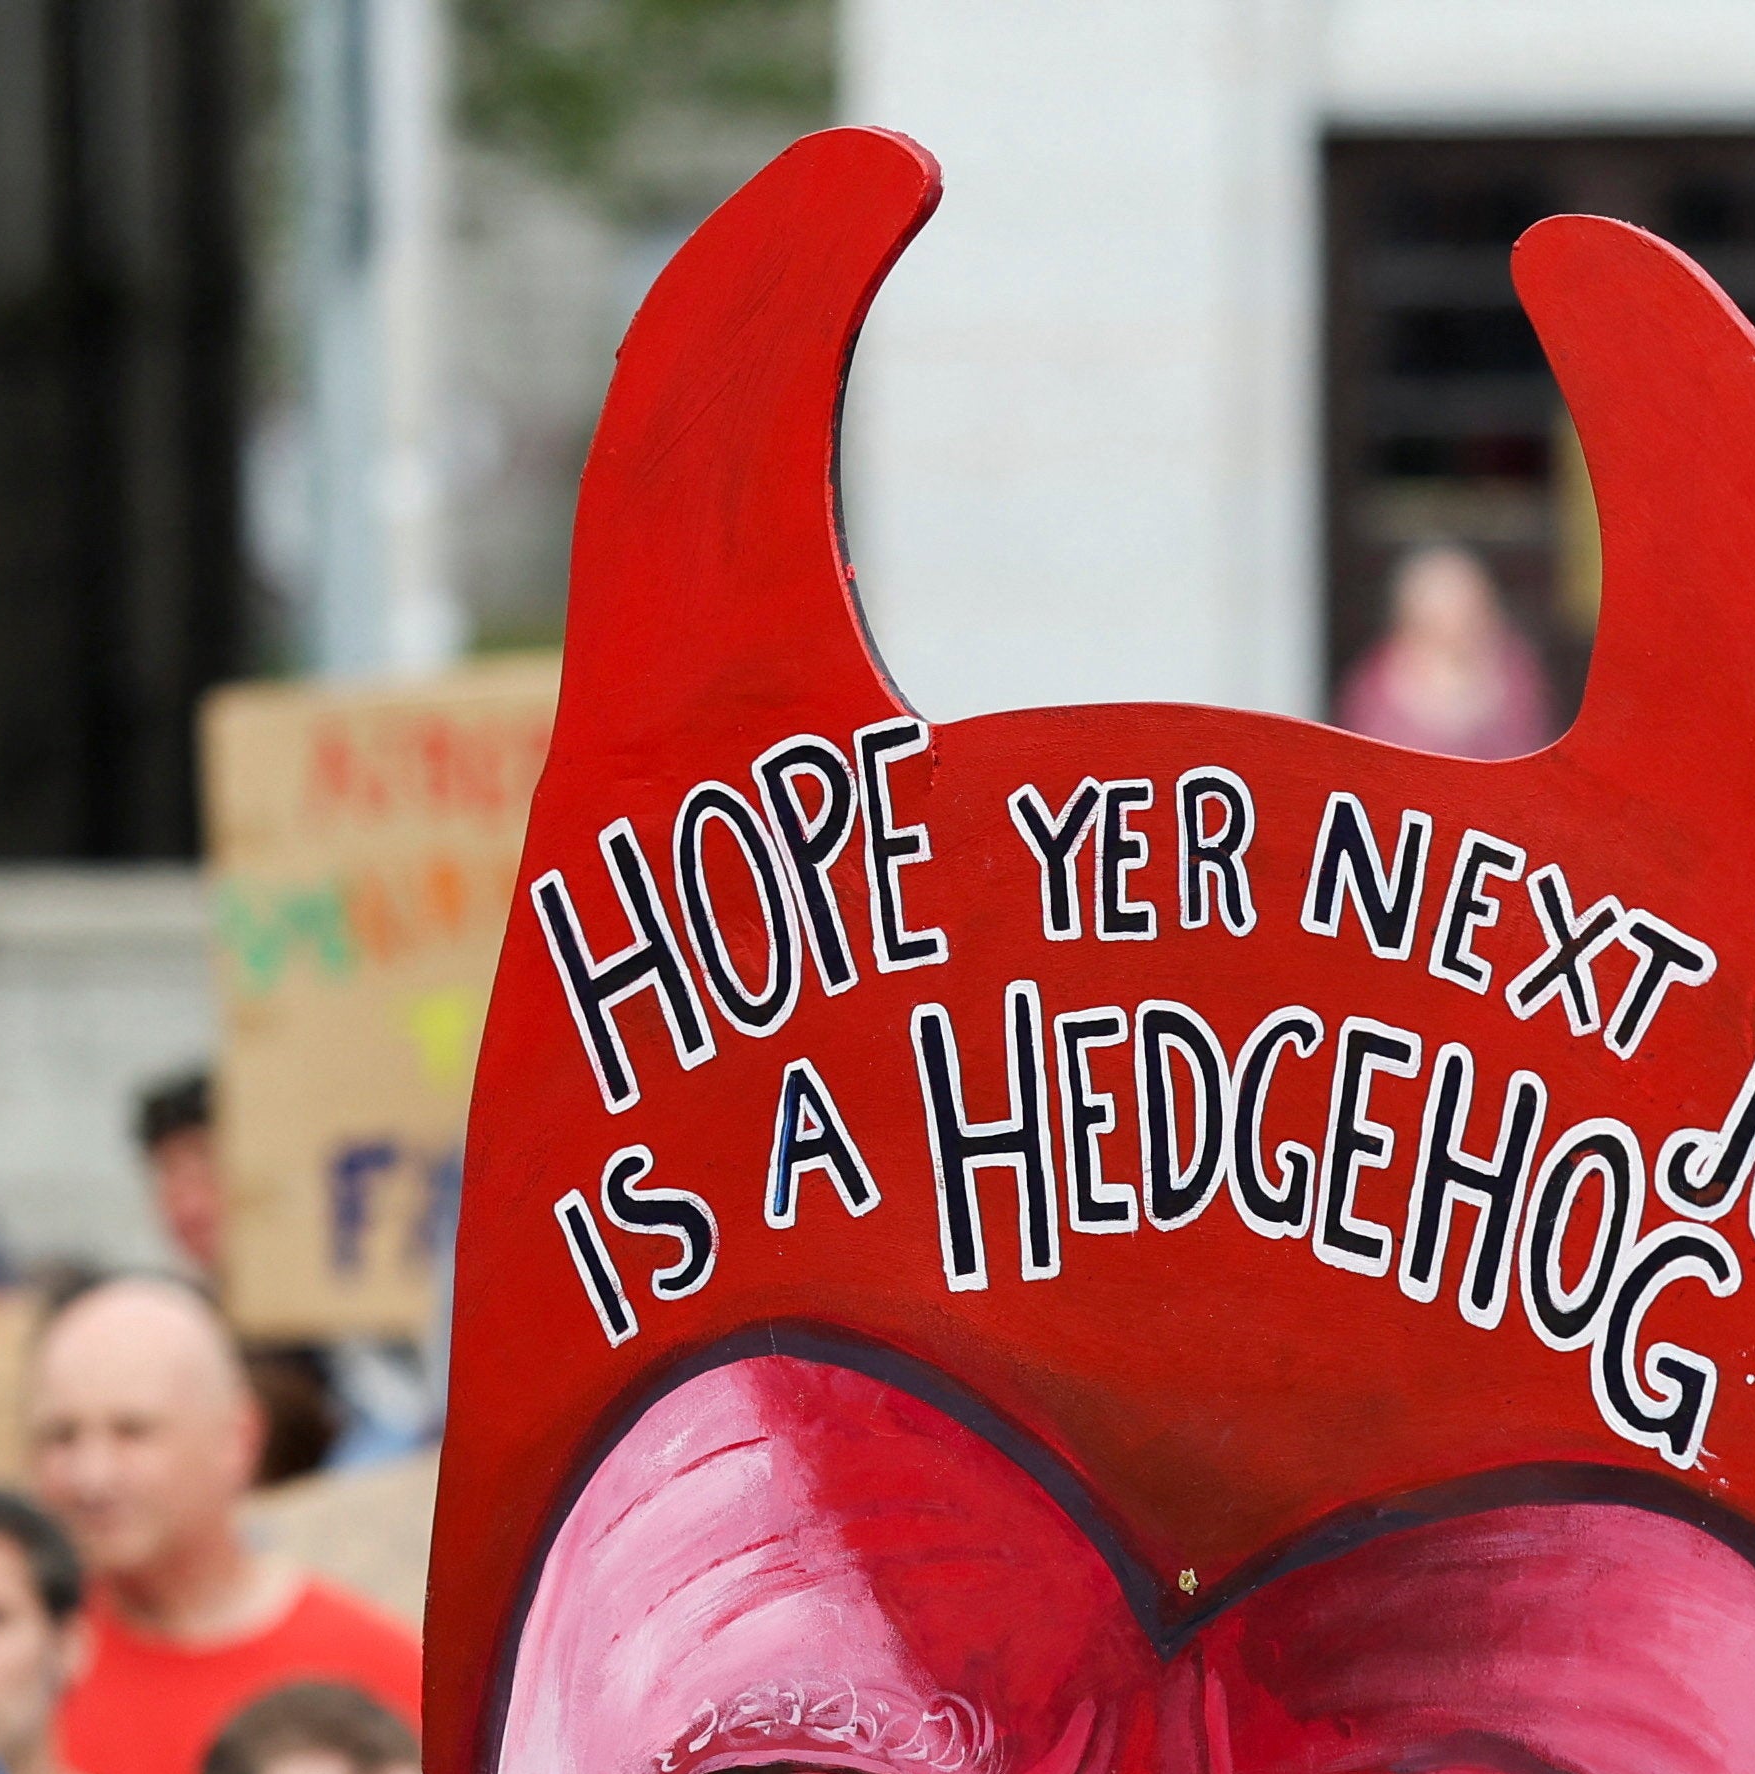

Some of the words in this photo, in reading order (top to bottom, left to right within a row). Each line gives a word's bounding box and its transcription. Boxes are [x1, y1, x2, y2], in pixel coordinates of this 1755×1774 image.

[532, 717, 948, 1113] HOPE
[1008, 765, 1257, 941] YER
[1301, 791, 1717, 1059] NEXT
[553, 1144, 720, 1348] IS
[764, 1057, 881, 1229] A
[911, 980, 1742, 1470] HEDGEHOG
